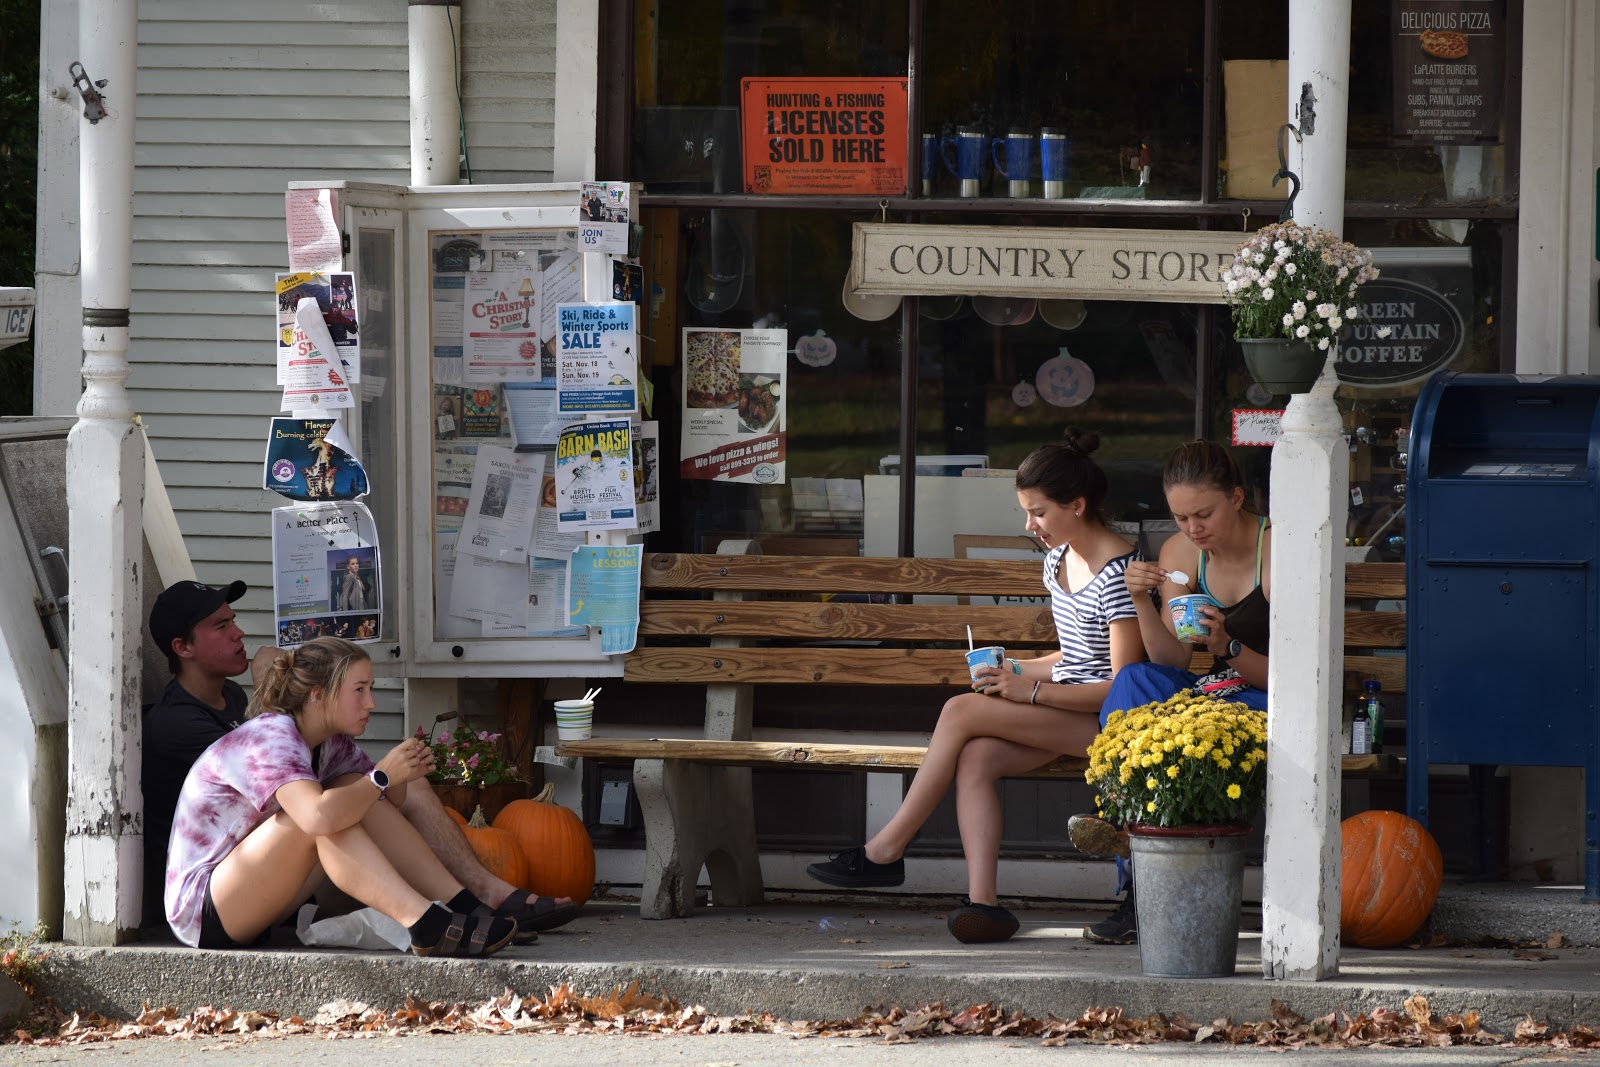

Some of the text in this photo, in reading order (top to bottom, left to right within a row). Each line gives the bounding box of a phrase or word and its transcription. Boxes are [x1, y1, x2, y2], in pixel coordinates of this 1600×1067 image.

[1402, 12, 1491, 29] DELICIOUS PIZZA
[1415, 64, 1476, 75] LaPLATTE BURGERS
[767, 94, 884, 107] HUNTING & FISHING
[1408, 95, 1482, 106] SUBS, PANINI, WRAPS
[768, 111, 884, 135] LICENSES
[769, 138, 885, 163] SOLD HERE
[890, 245, 1236, 282] COUNTRY STORE
[284, 276, 298, 285] THIS
[499, 292, 508, 302] A
[472, 298, 535, 318] CHRISTMAS
[562, 309, 616, 322] Ski, Ride &
[1348, 302, 1415, 318] REEN
[5, 309, 28, 333] ICE
[490, 312, 522, 329] STORY
[562, 321, 628, 332] Winter Sports
[1345, 324, 1440, 340] UNTAIN
[562, 333, 601, 349] SALE
[276, 429, 305, 440] Burning
[559, 429, 628, 458] BARN BASH
[695, 457, 708, 468] We
[709, 453, 724, 464] love
[726, 448, 744, 460] pizza
[753, 438, 778, 452] wings!
[720, 463, 730, 471] call
[731, 456, 756, 469] 899-3313
[764, 451, 779, 460] order
[491, 461, 510, 469] SAXON
[500, 470, 516, 478] OPEN
[607, 548, 636, 558] VOICE
[593, 558, 637, 568] LESSONS
